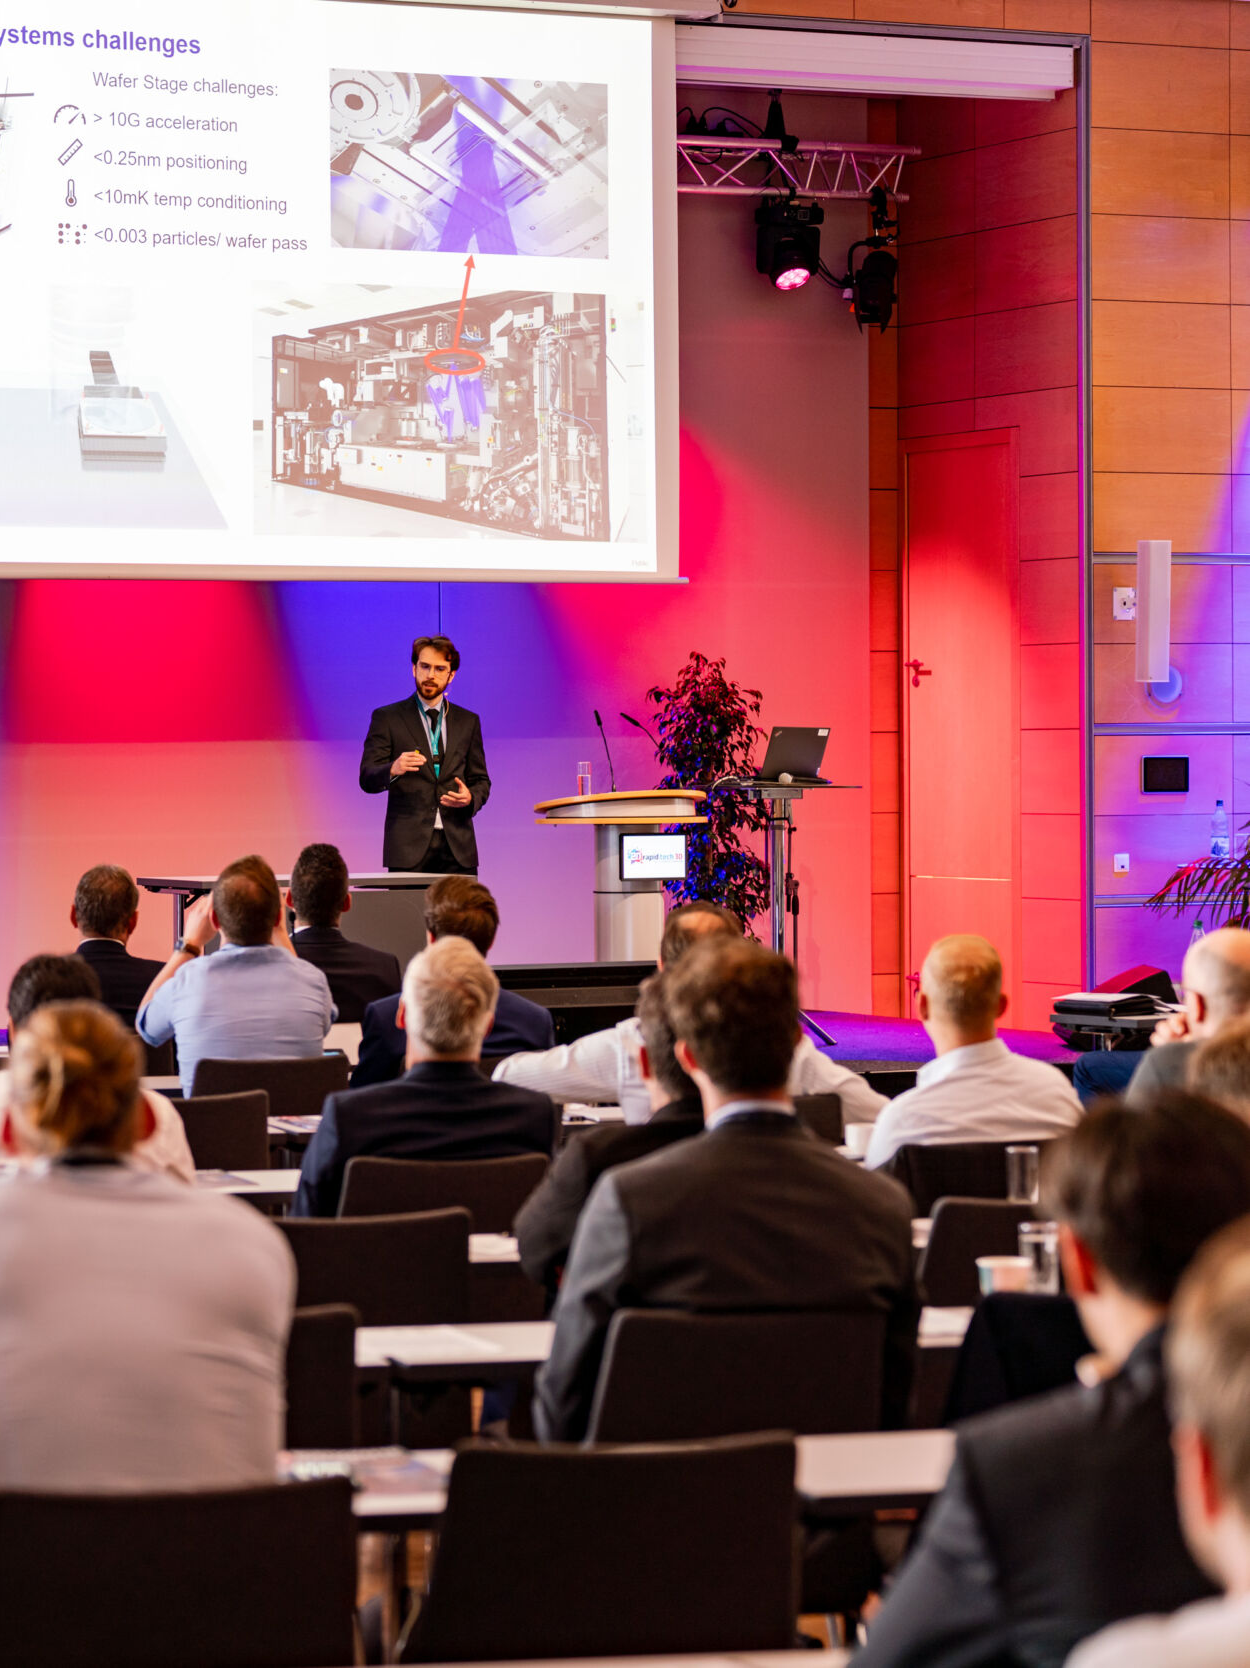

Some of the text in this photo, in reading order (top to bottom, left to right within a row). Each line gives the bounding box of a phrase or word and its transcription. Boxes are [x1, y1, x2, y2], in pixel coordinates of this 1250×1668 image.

[82, 29, 202, 59] challenges
[92, 71, 279, 99] Wafer Stage challenges:
[109, 111, 141, 128] 10G
[145, 114, 238, 133] acceleration
[93, 149, 248, 175] <0.25nm positioning
[93, 188, 287, 216] <10mK temp conditioning
[93, 227, 308, 254] <0.003 particles/ wafer pass
